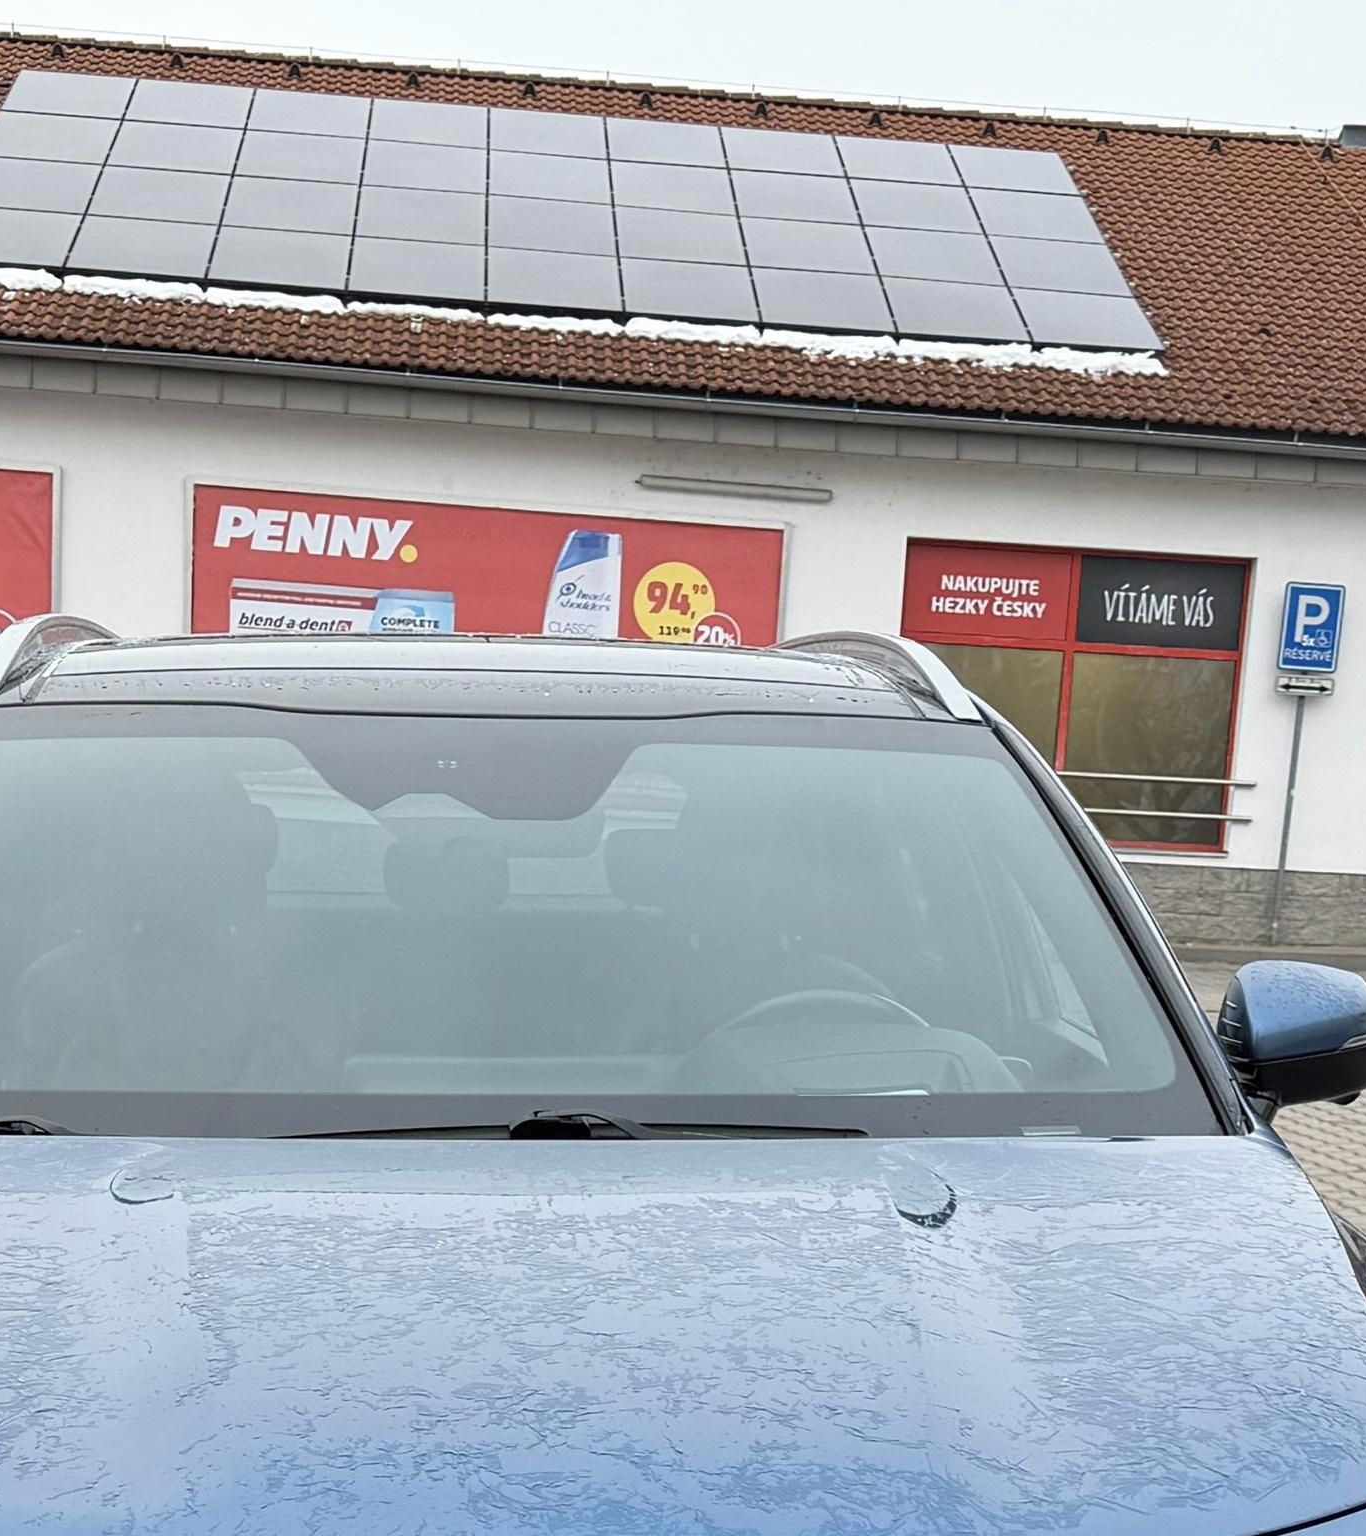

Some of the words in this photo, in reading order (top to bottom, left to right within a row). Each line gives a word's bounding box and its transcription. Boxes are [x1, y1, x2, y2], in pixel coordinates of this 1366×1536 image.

[941, 575, 1040, 598] NAKUPUJTE
[931, 596, 988, 615] HEZKY
[992, 596, 1046, 618] ČESKY
[1104, 583, 1178, 626] VÍTÁME
[1182, 588, 1214, 627] VÁS
[1294, 595, 1330, 642] P
